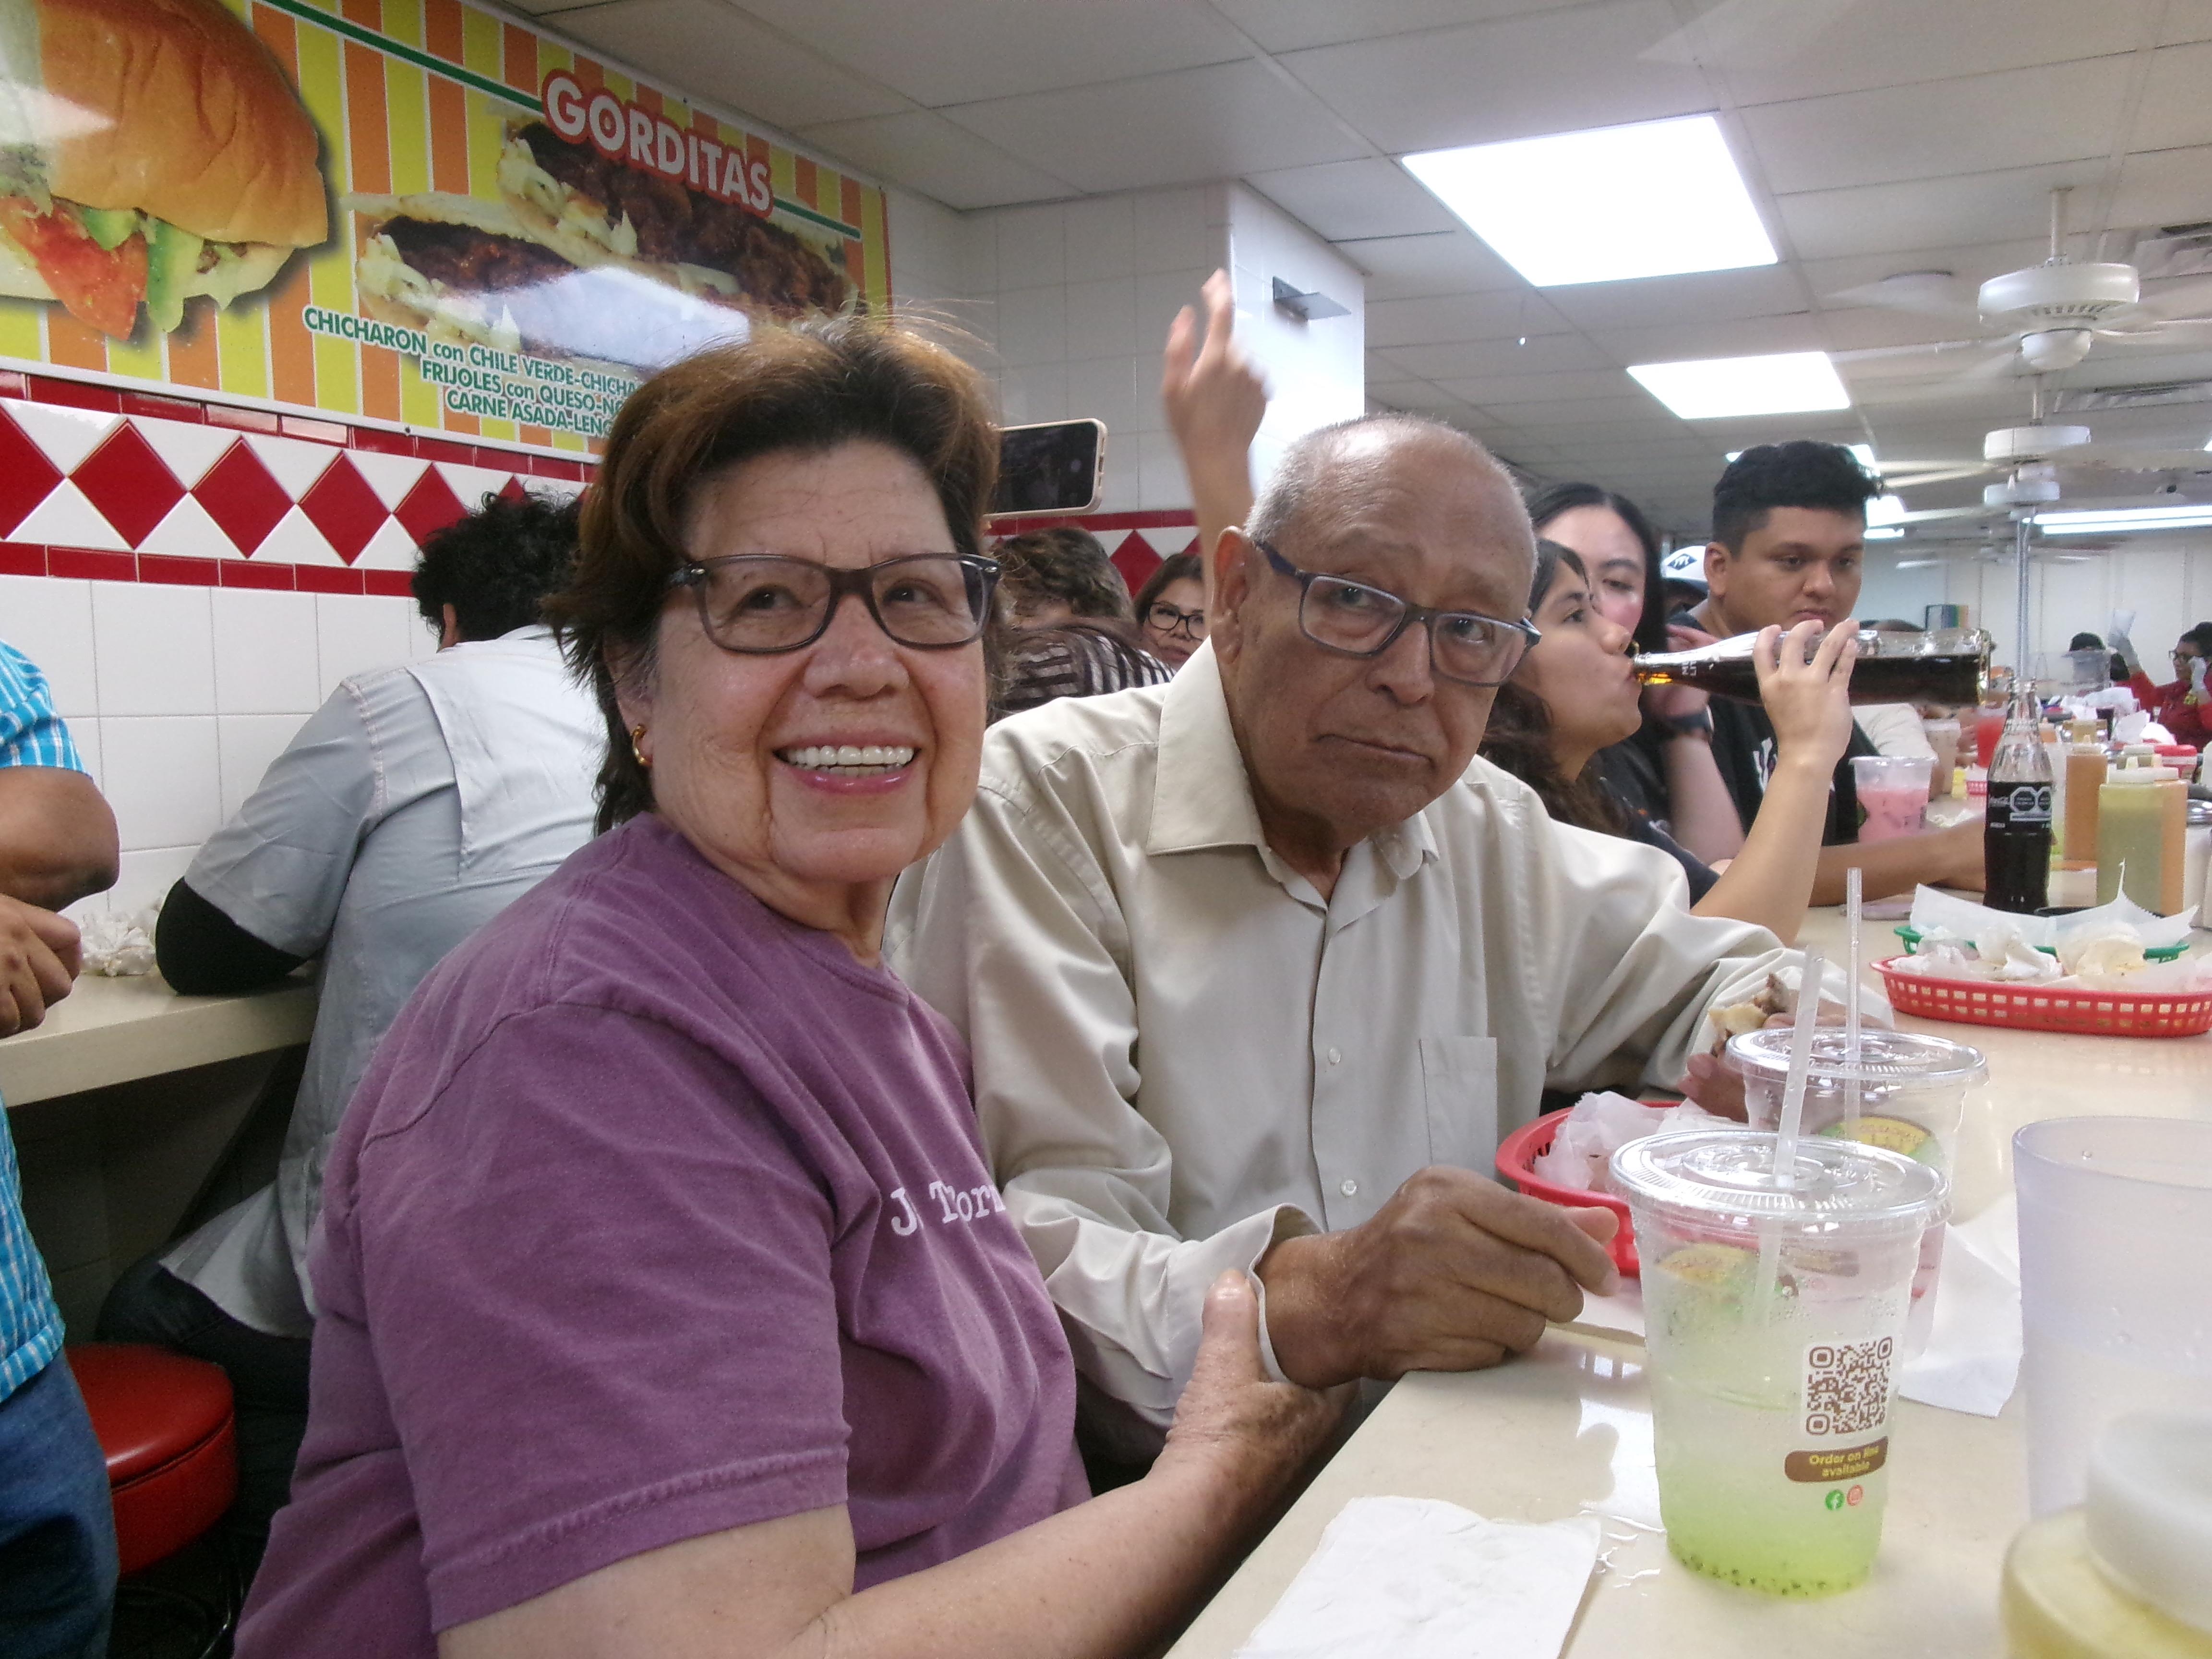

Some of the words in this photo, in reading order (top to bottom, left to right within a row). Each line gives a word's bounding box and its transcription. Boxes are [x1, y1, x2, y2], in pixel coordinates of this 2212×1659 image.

[548, 77, 770, 211] GORDITAS
[304, 307, 427, 354] CHICHARON
[433, 343, 464, 362] con
[470, 346, 518, 373] CHILE
[422, 360, 502, 394] FRIJOLES
[506, 383, 534, 400] con
[447, 390, 507, 417] CARNE
[1809, 1454, 1845, 1465] Order
